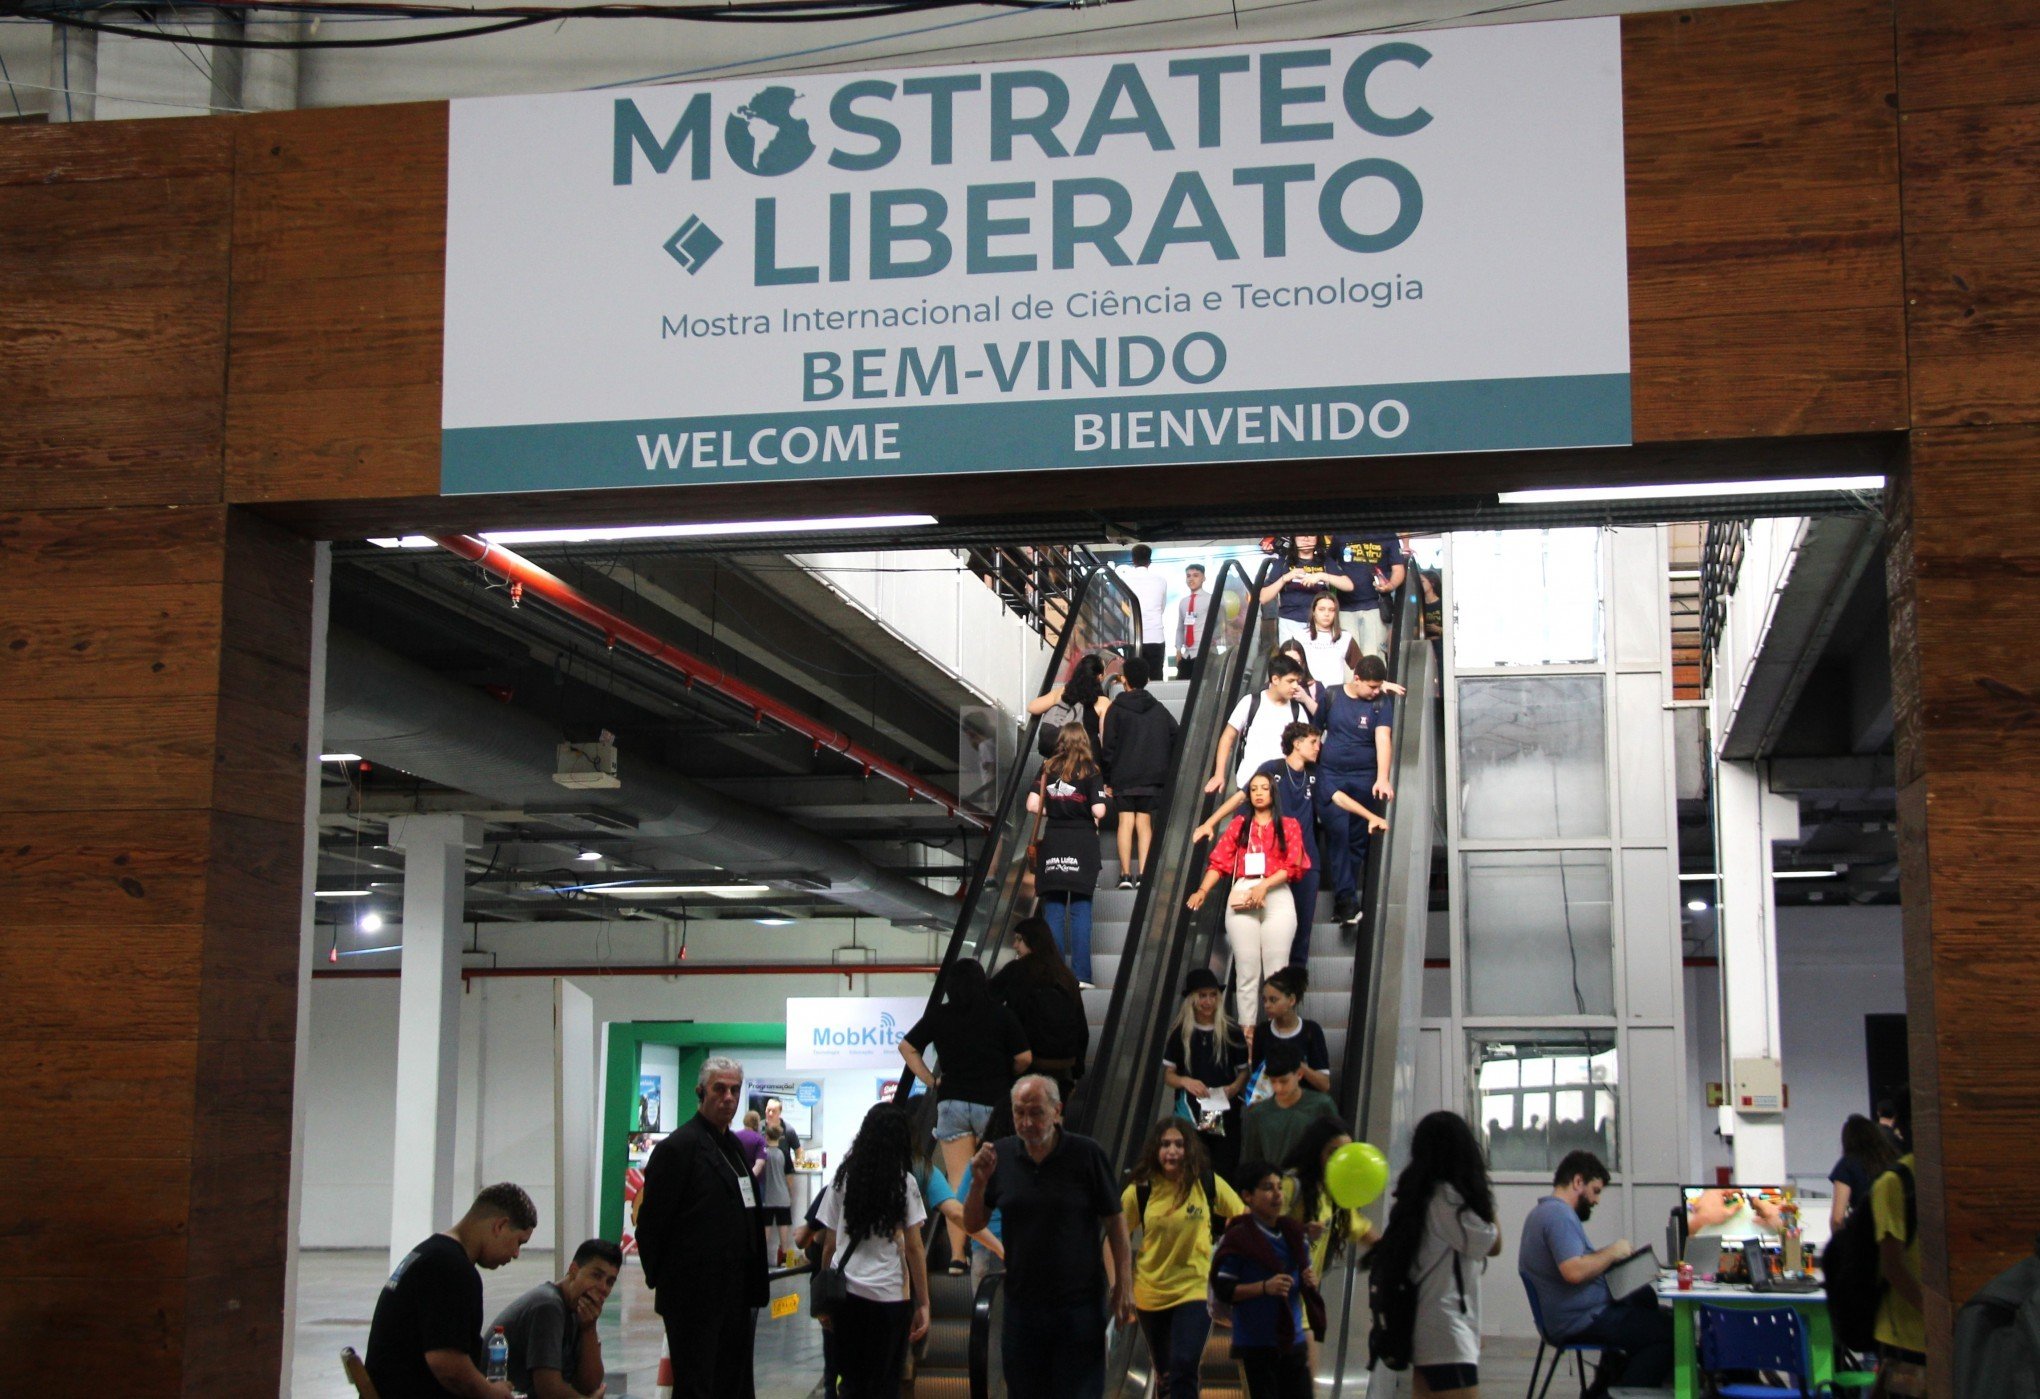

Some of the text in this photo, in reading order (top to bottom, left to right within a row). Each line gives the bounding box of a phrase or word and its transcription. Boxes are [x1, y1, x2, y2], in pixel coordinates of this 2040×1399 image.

[613, 42, 1434, 186] MOSTRATEC
[754, 158, 1424, 286] LIBERATO
[661, 274, 1424, 339] Mostra Internacional de Ciência e Tecnologia
[803, 331, 1227, 402] BEM-VINDO
[636, 423, 900, 470] WELCOME
[1074, 399, 1409, 451] BIENVENIDO
[813, 1024, 906, 1046] MobKits
